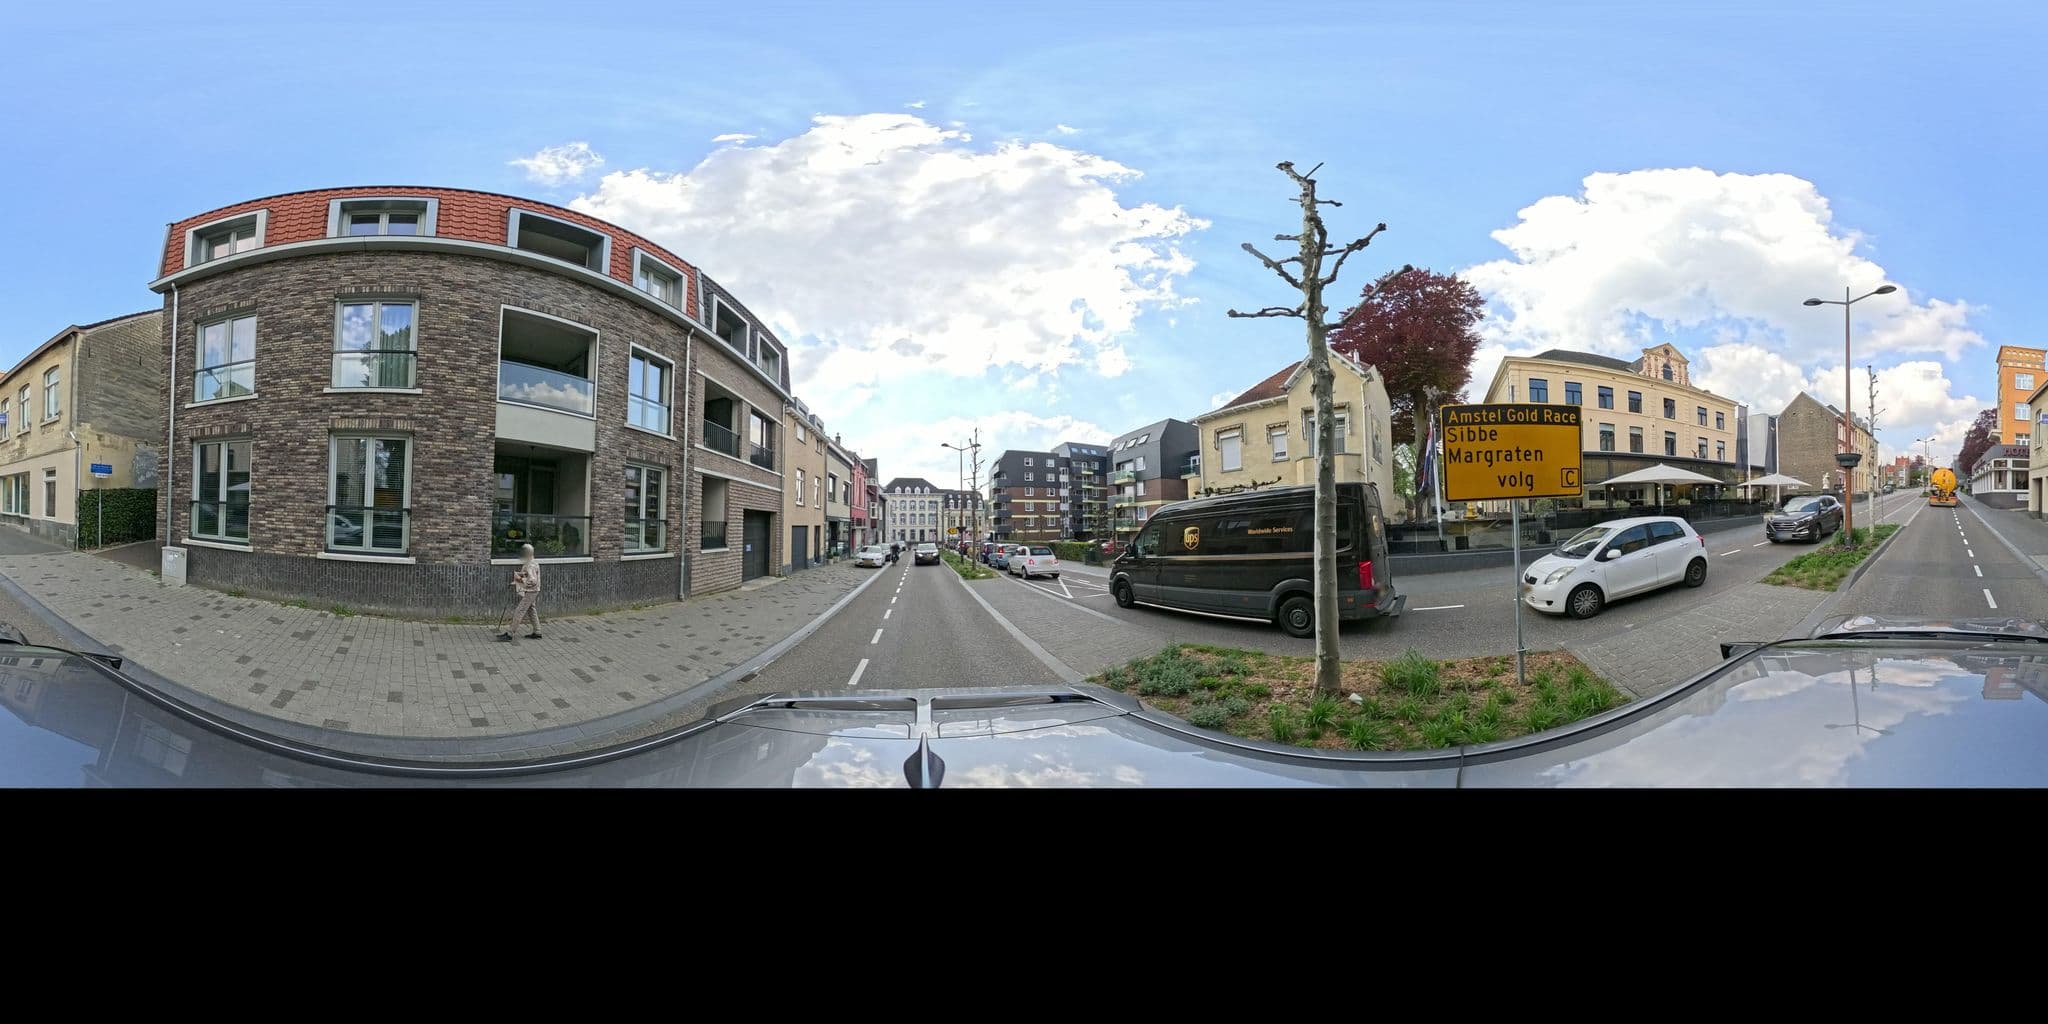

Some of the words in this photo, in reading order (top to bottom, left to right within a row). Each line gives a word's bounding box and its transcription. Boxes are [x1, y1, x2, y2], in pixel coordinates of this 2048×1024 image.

[1448, 409, 1501, 423] Amstel
[1506, 408, 1538, 423] Gold
[1543, 409, 1577, 423] Race
[1447, 427, 1498, 443] Sibbe
[1448, 446, 1544, 467] Margraten
[1497, 471, 1534, 491] volg
[1565, 470, 1575, 486] C
[1185, 533, 1198, 547] ups
